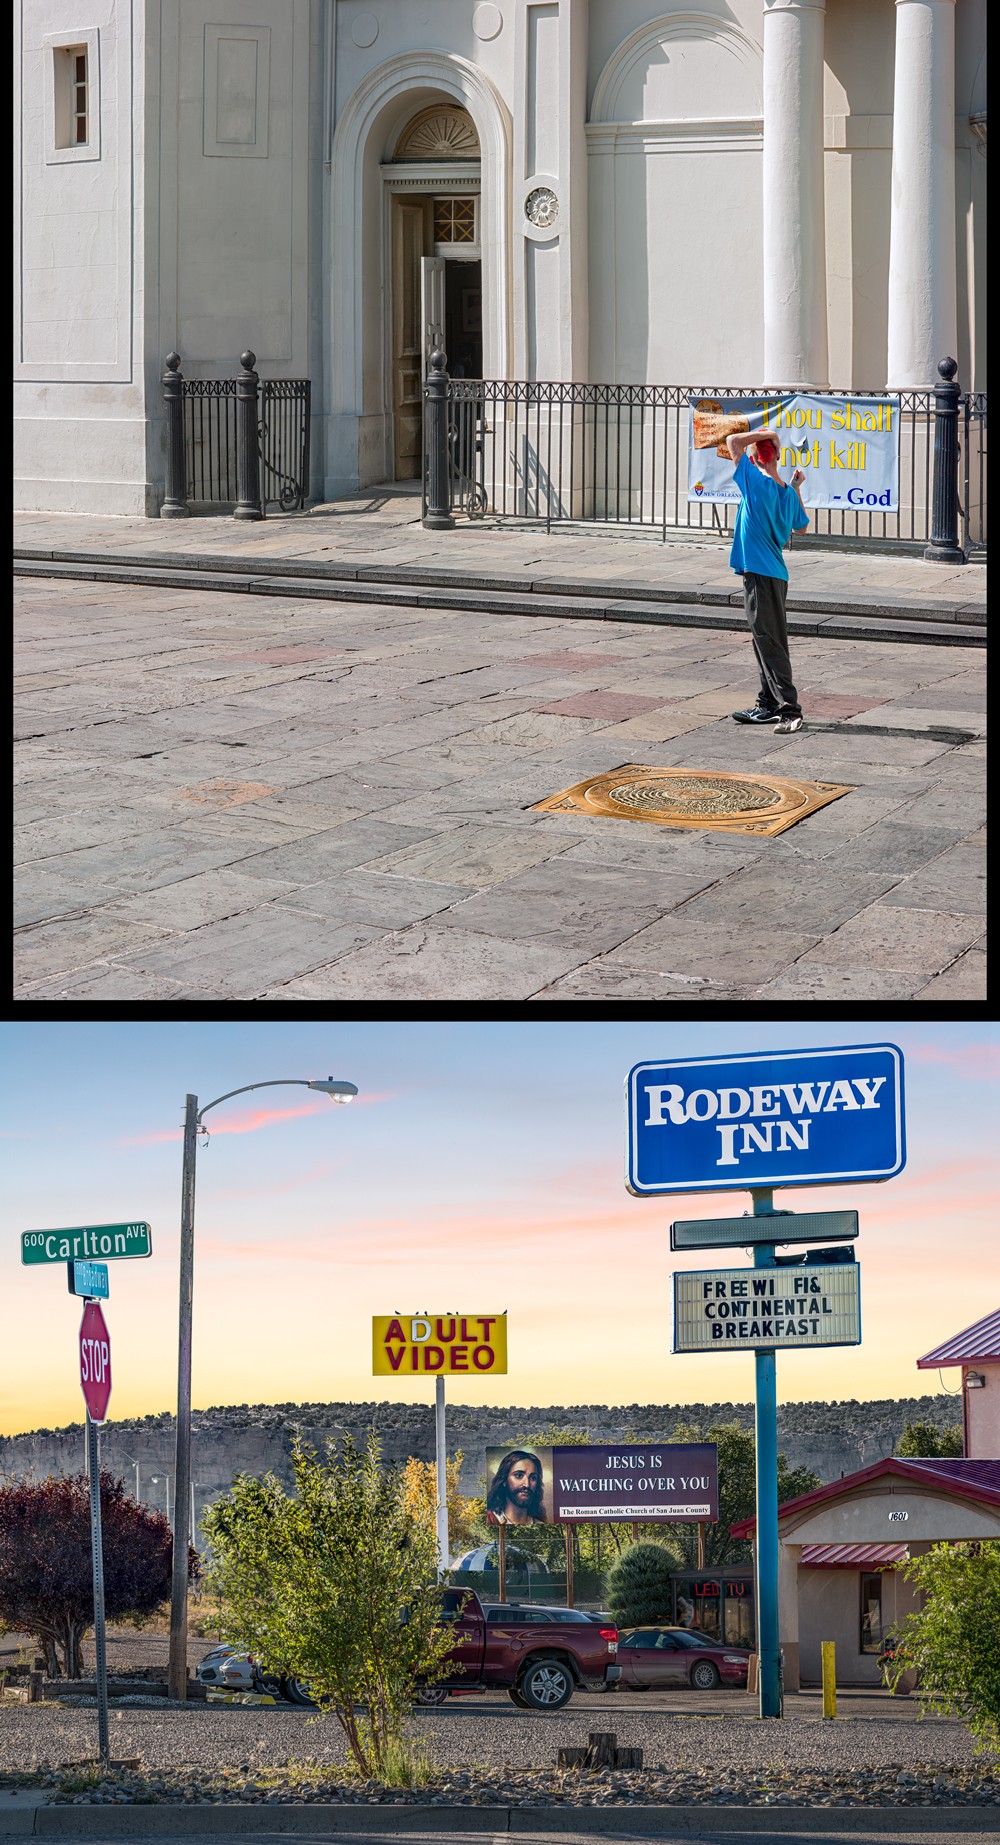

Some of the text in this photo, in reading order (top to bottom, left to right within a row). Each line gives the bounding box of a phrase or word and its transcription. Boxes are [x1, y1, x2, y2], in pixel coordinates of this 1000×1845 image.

[756, 401, 894, 432] Thou shalt
[781, 440, 866, 470] not kill
[847, 488, 891, 507] God
[644, 1077, 887, 1126] RODEWAY
[716, 1119, 812, 1166] INN
[24, 1224, 146, 1259] 600 Carlton AVE
[83, 1265, 107, 1295] Broadway
[705, 1298, 832, 1319] CONTINENTAL
[384, 1318, 496, 1343] ADULT
[712, 1319, 819, 1339] BREAKFAST
[81, 1338, 109, 1383] STOP
[385, 1345, 495, 1370] VIDEO
[605, 1455, 662, 1469] JESUS IS
[559, 1476, 710, 1492] WATCHING OVER YOU
[685, 1506, 708, 1515] County
[890, 1512, 906, 1521] 1601
[695, 1582, 745, 1596] LED TV
